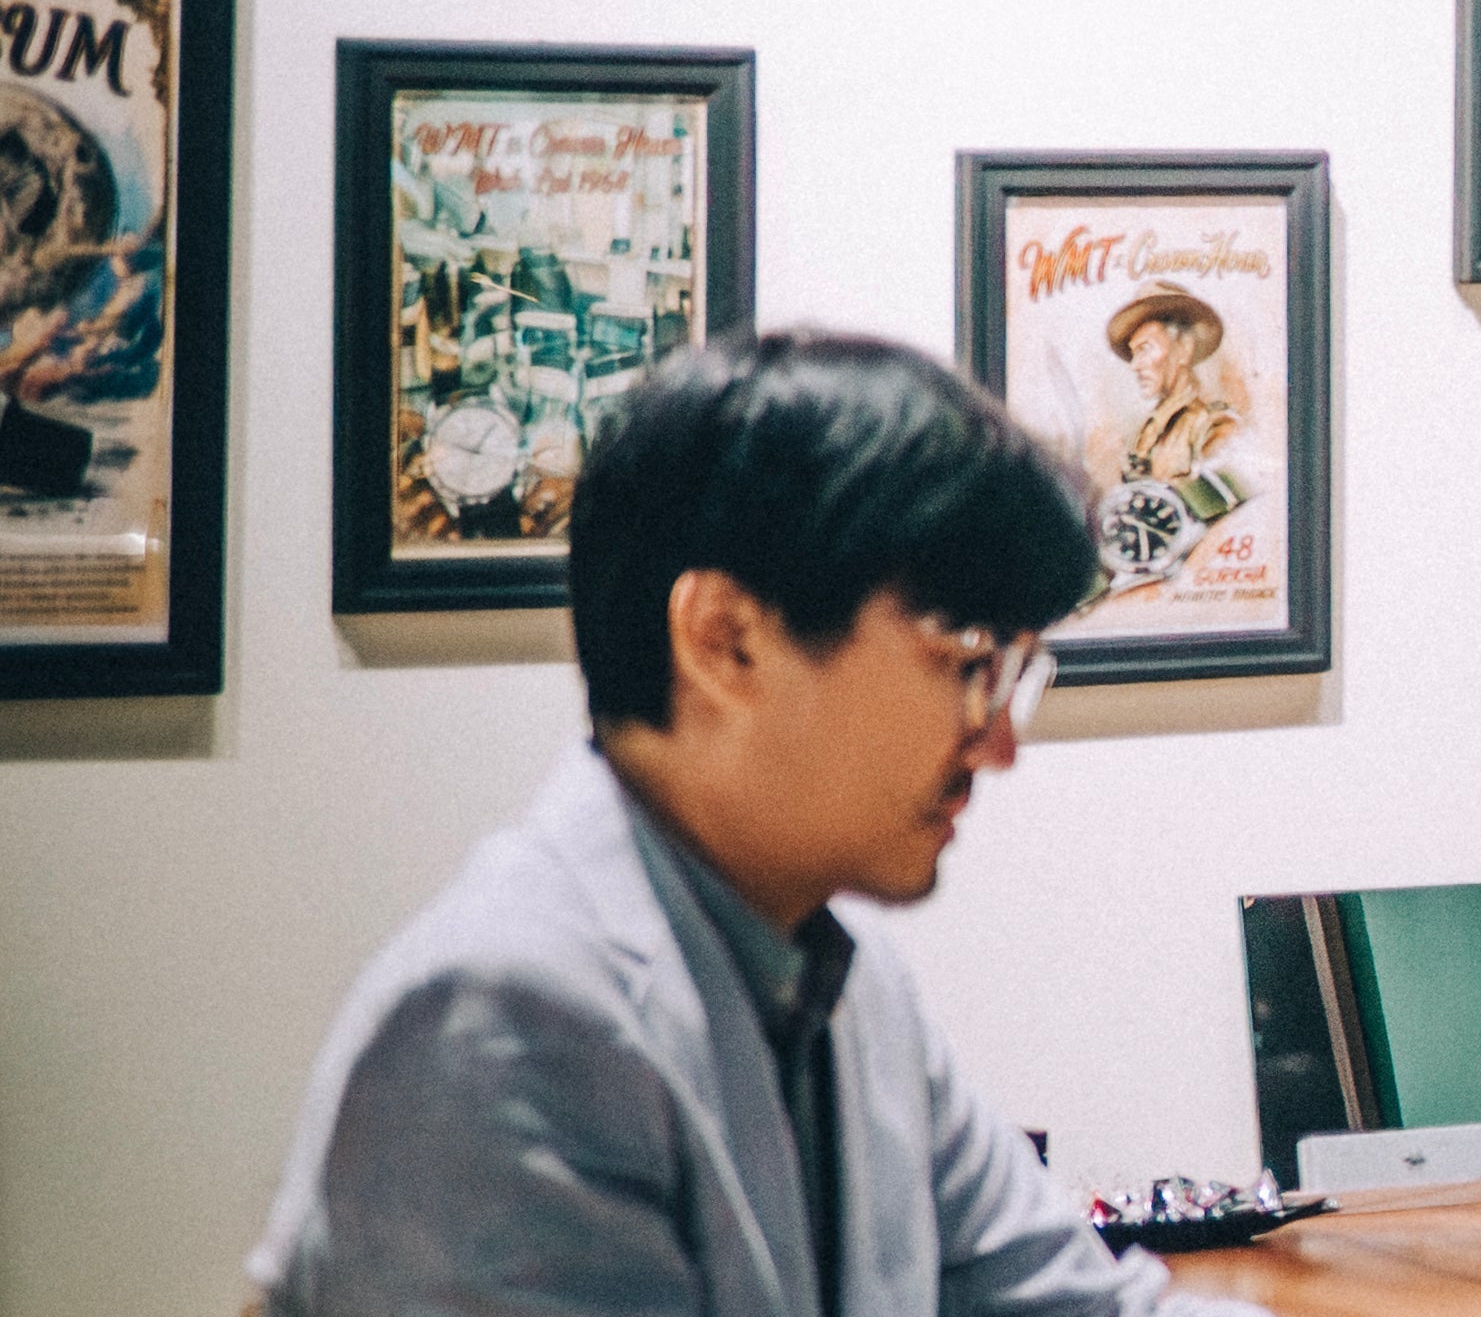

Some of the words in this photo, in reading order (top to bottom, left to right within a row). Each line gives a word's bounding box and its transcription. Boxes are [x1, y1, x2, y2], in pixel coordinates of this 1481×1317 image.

[0, 2, 132, 97] UM
[1018, 224, 1125, 303] WMT
[1218, 534, 1253, 562] 48
